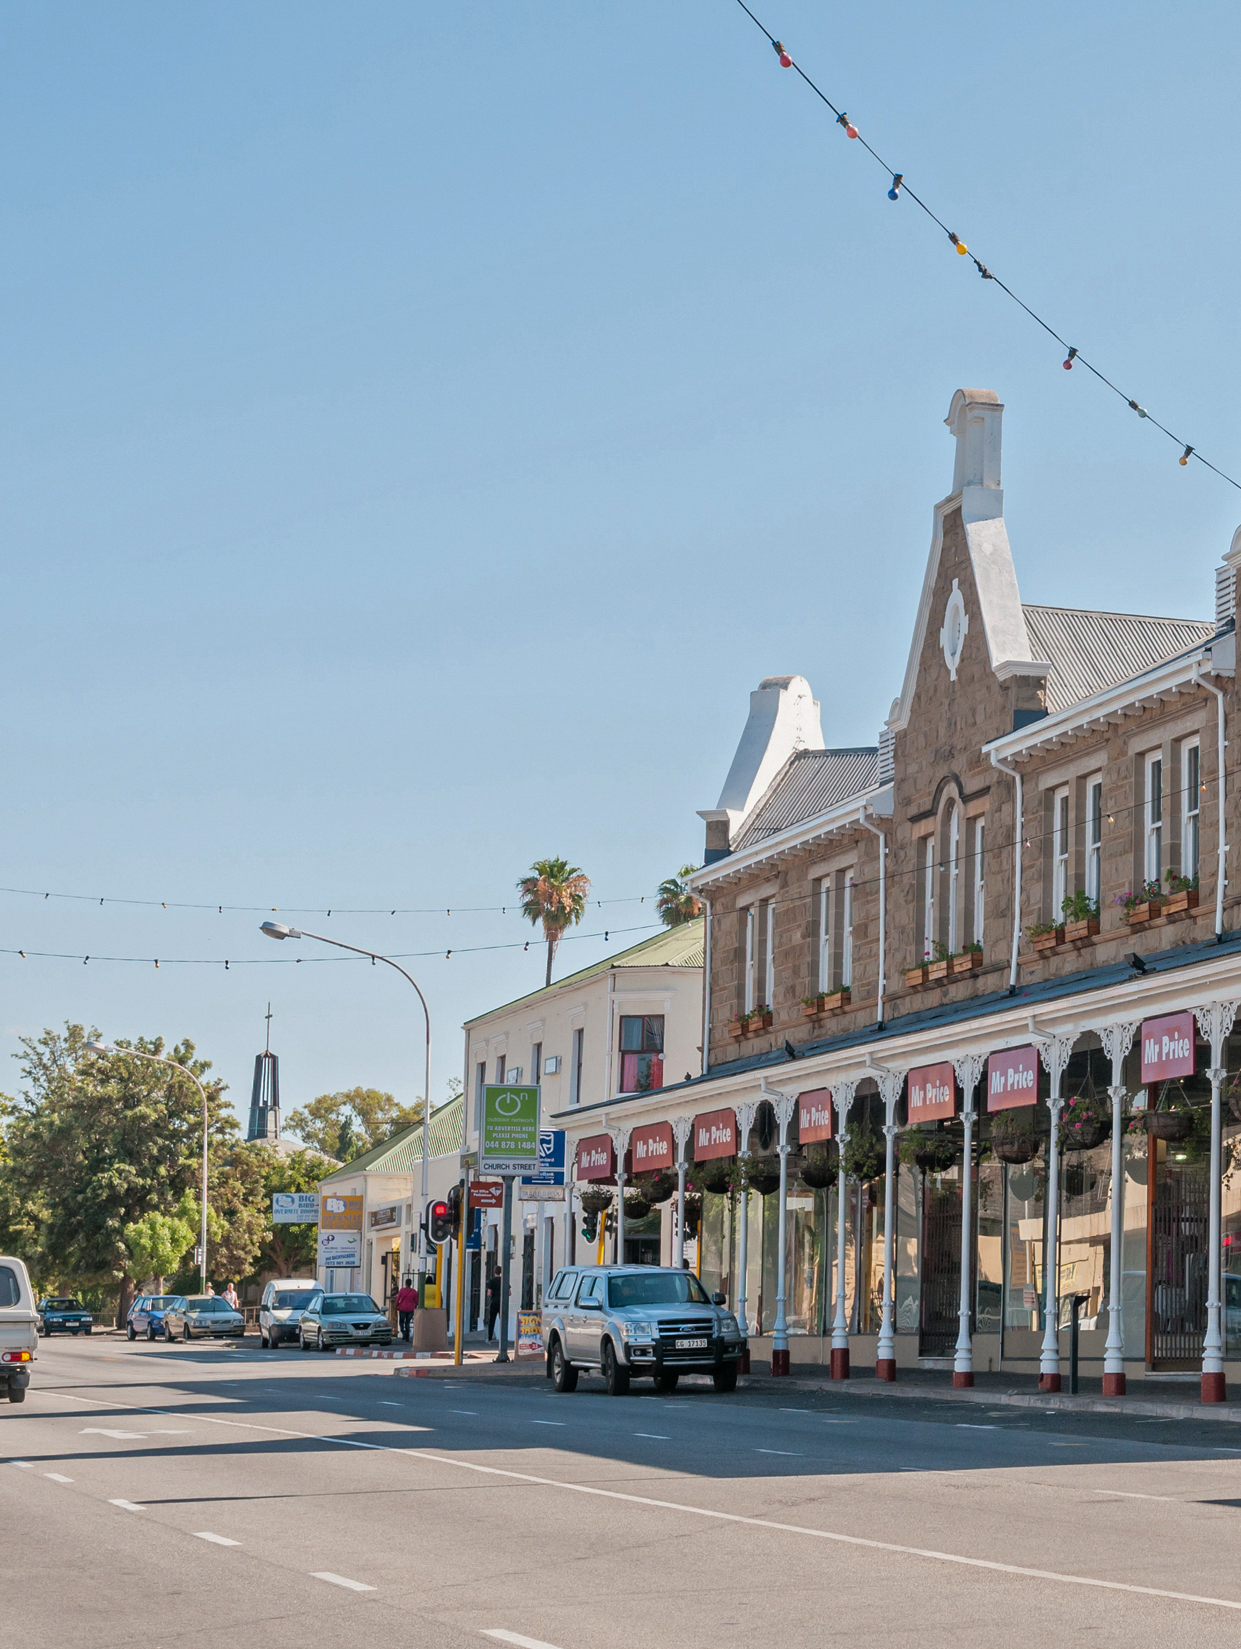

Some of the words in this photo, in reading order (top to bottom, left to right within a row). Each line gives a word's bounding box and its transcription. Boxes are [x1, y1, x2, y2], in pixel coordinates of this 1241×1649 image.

[1144, 1039, 1159, 1065] Mr
[1161, 1031, 1190, 1061] Price
[990, 1071, 1005, 1095] Mr
[1007, 1064, 1034, 1091] Price
[911, 1085, 924, 1108] Mr
[926, 1079, 950, 1105] Price
[800, 1108, 810, 1129] Mr
[811, 1104, 829, 1126] Price
[485, 1140, 499, 1148] 044
[501, 1141, 515, 1149] 878
[517, 1141, 535, 1149] 1484
[698, 1127, 710, 1147] Mr
[711, 1123, 732, 1145] Price
[580, 1151, 590, 1169] Mr
[591, 1147, 607, 1167] Price
[636, 1141, 647, 1159] Mr
[648, 1136, 668, 1156] Price
